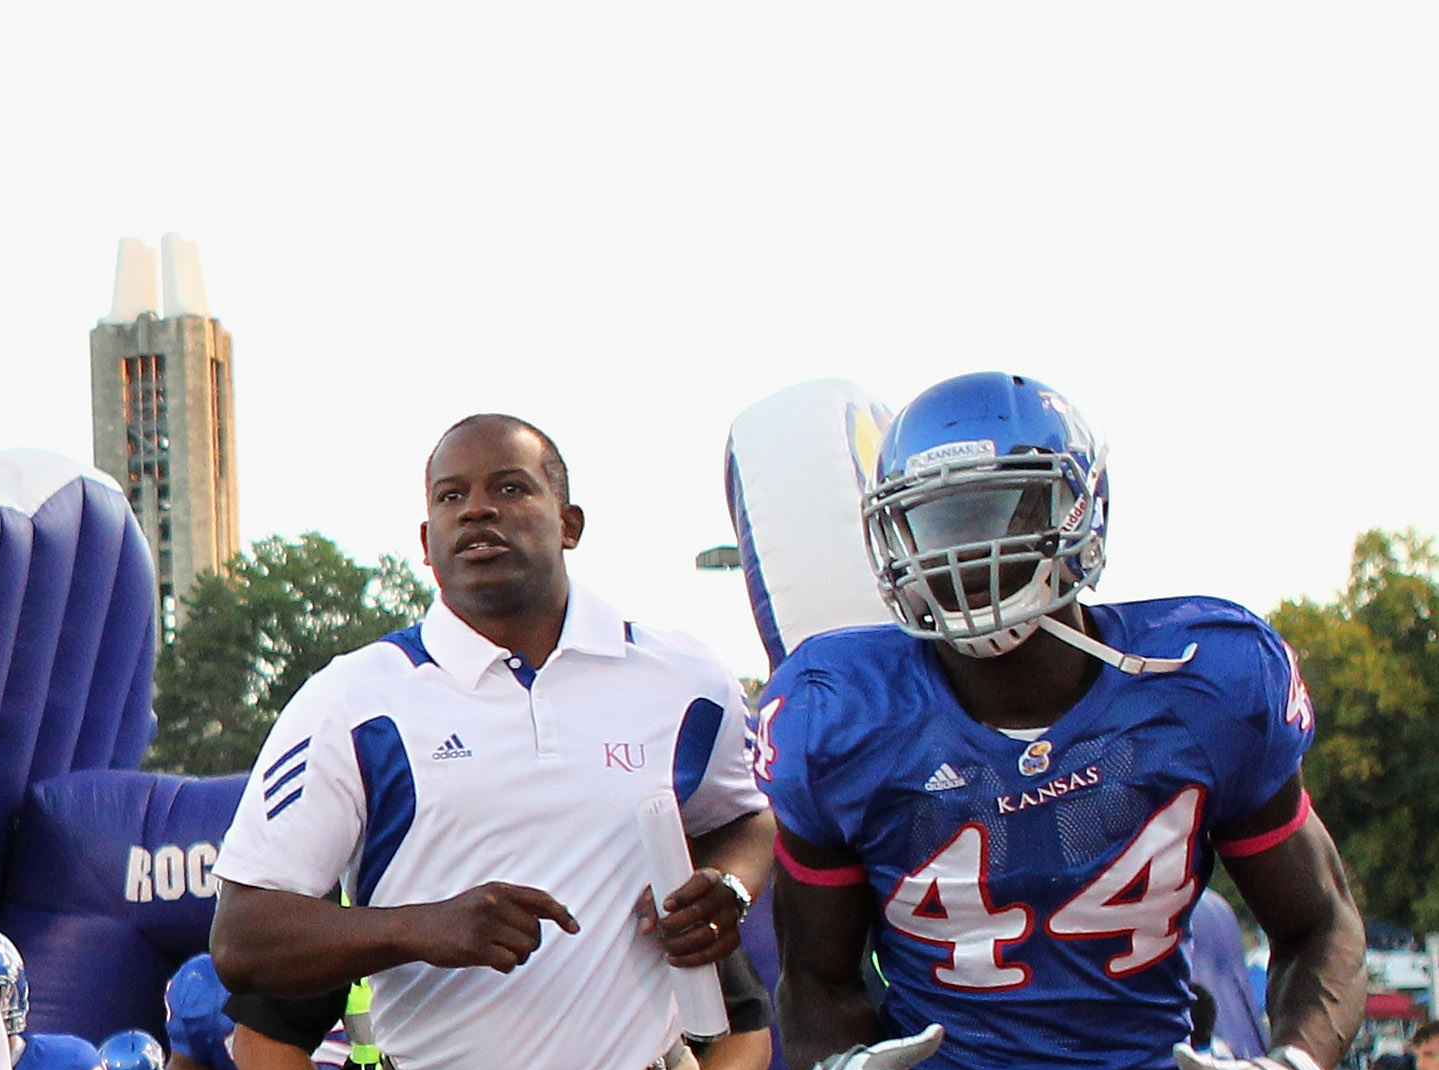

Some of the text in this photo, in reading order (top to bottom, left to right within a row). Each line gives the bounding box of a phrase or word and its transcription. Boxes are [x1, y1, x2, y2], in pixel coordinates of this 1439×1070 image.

[432, 748, 472, 760] adidas
[603, 743, 646, 773] KU
[997, 766, 1101, 815] KANSAS
[125, 842, 222, 903] ROC
[884, 784, 1207, 992] 44
